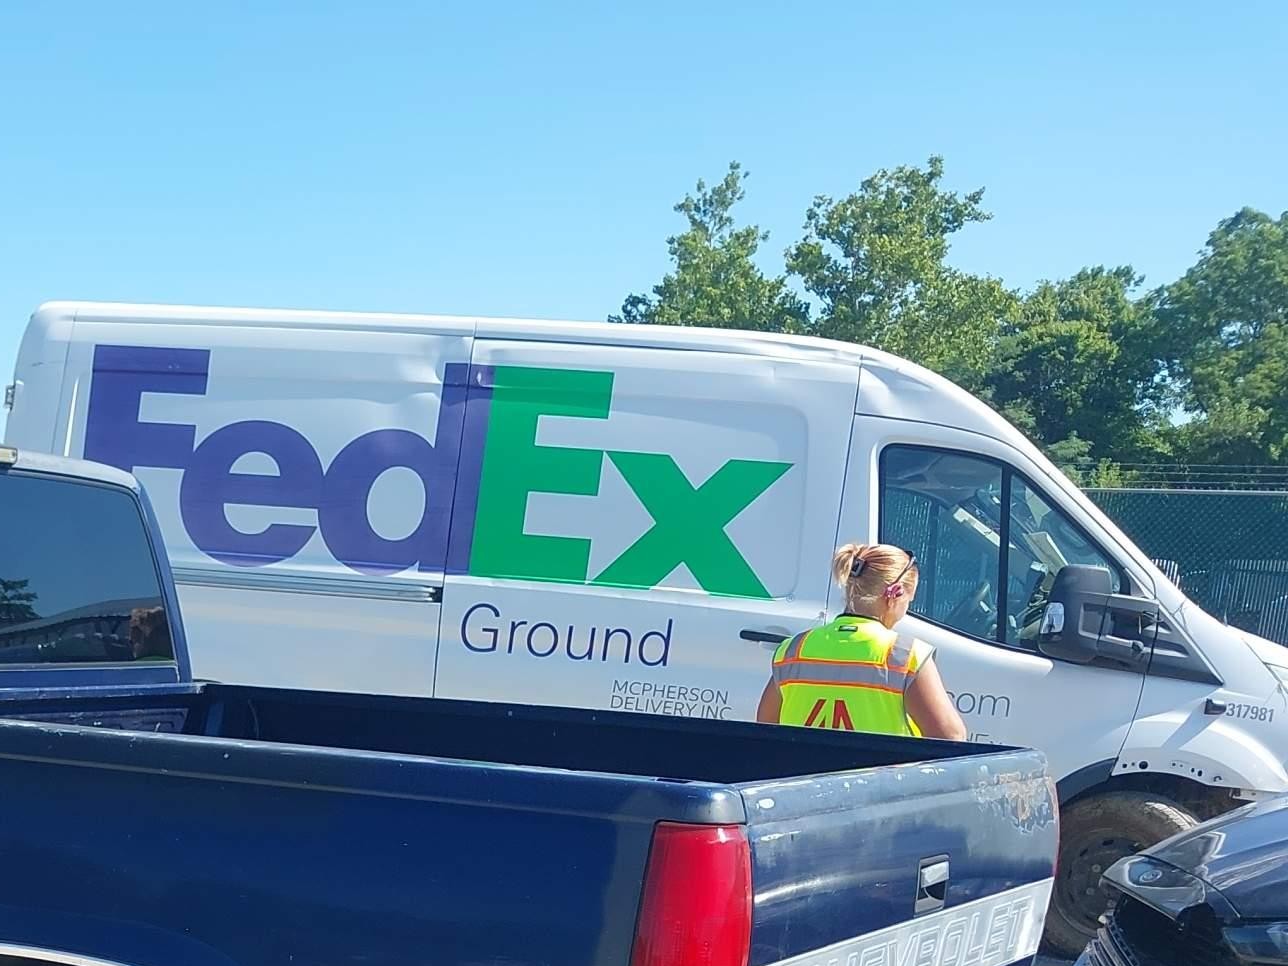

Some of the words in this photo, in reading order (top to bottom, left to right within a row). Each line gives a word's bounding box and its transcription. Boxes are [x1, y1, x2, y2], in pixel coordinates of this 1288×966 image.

[84, 344, 795, 600] FedEx
[461, 603, 673, 667] Ground
[613, 680, 728, 704] MCPHERSON
[611, 695, 698, 717] DELIVERY
[701, 706, 732, 720] INC
[1226, 703, 1274, 722] 317981
